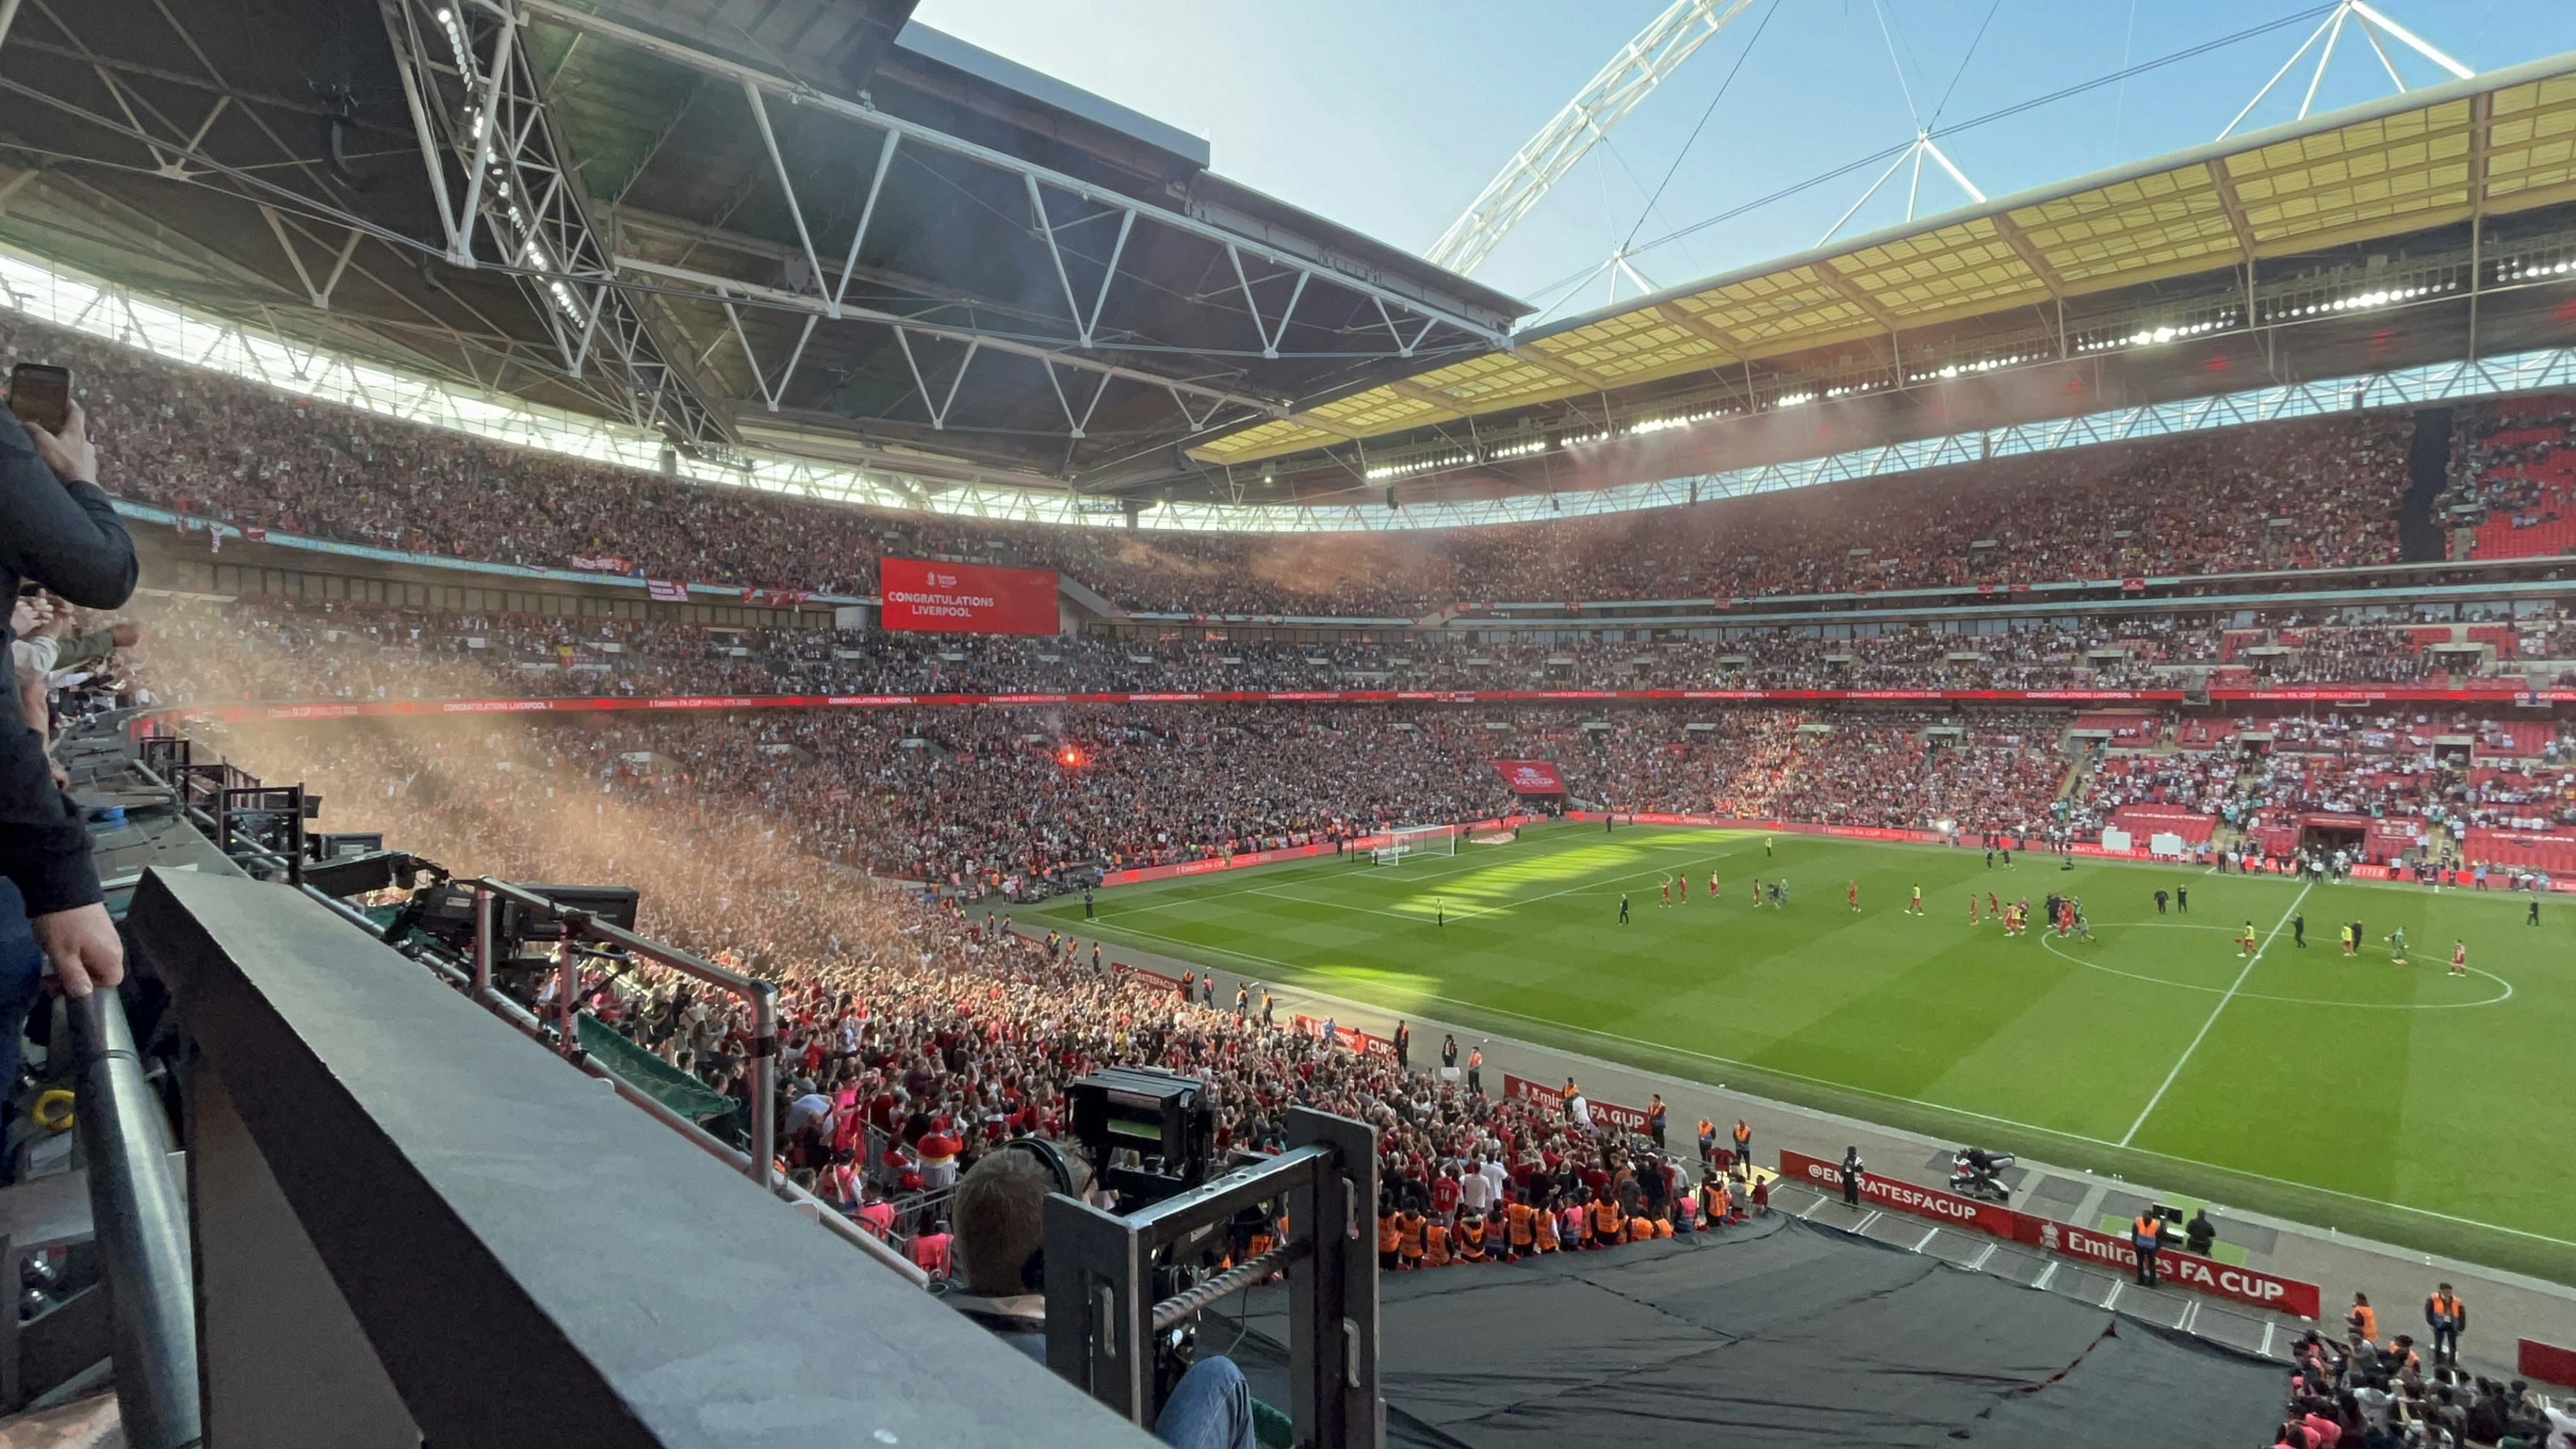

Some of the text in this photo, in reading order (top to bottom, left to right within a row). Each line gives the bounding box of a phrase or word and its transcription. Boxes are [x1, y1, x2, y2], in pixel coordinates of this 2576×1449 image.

[888, 591, 994, 607] CONGRATULATIONS
[913, 605, 972, 617] LIVERPOOL
[509, 702, 546, 710] LIVERPOOL
[1368, 1039, 1390, 1055] CUP
[1589, 1104, 1609, 1122] FA
[1611, 1109, 1645, 1129] CUP
[1439, 1188, 1450, 1202] 14
[1808, 1164, 1977, 1220] @EMRATESFACUP
[2068, 1231, 2284, 1300] Emiraes FA CUP
